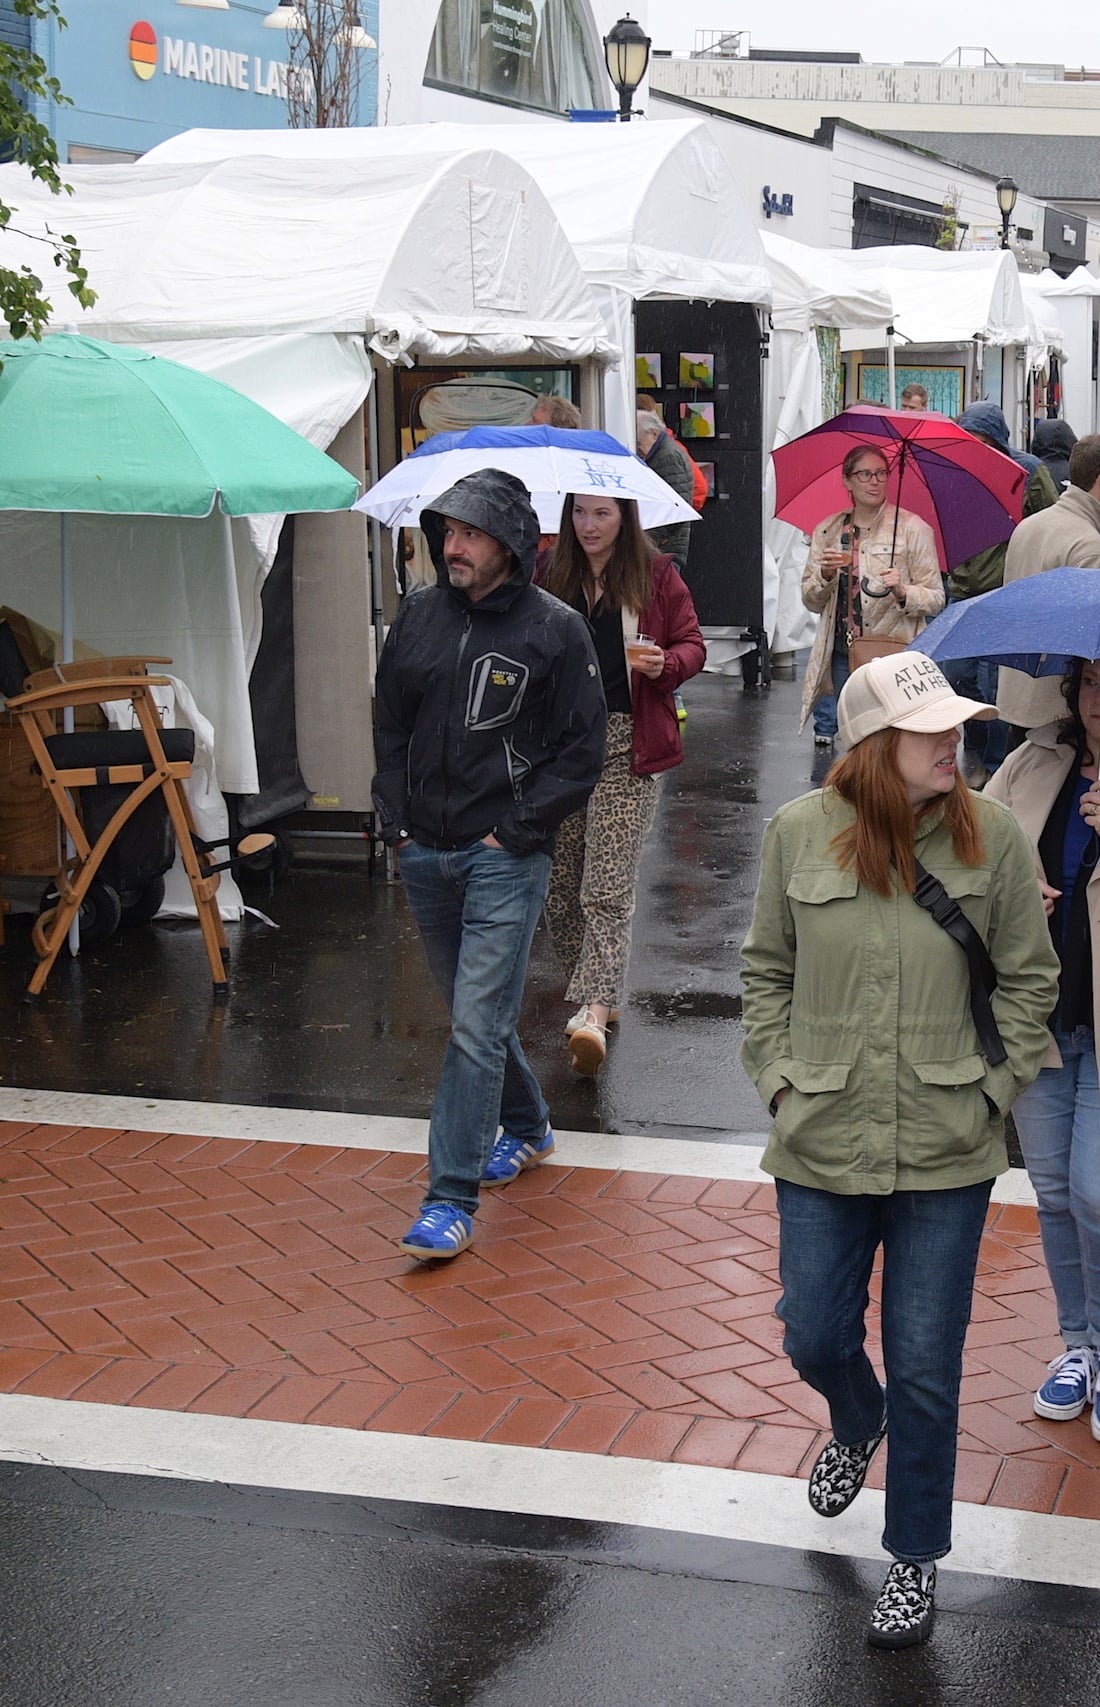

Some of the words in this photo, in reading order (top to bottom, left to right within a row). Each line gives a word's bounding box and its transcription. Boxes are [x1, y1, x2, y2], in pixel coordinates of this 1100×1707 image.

[163, 36, 249, 91] MARINE
[583, 471, 626, 489] NY
[894, 667, 912, 687] AT
[903, 680, 929, 701] I'M
